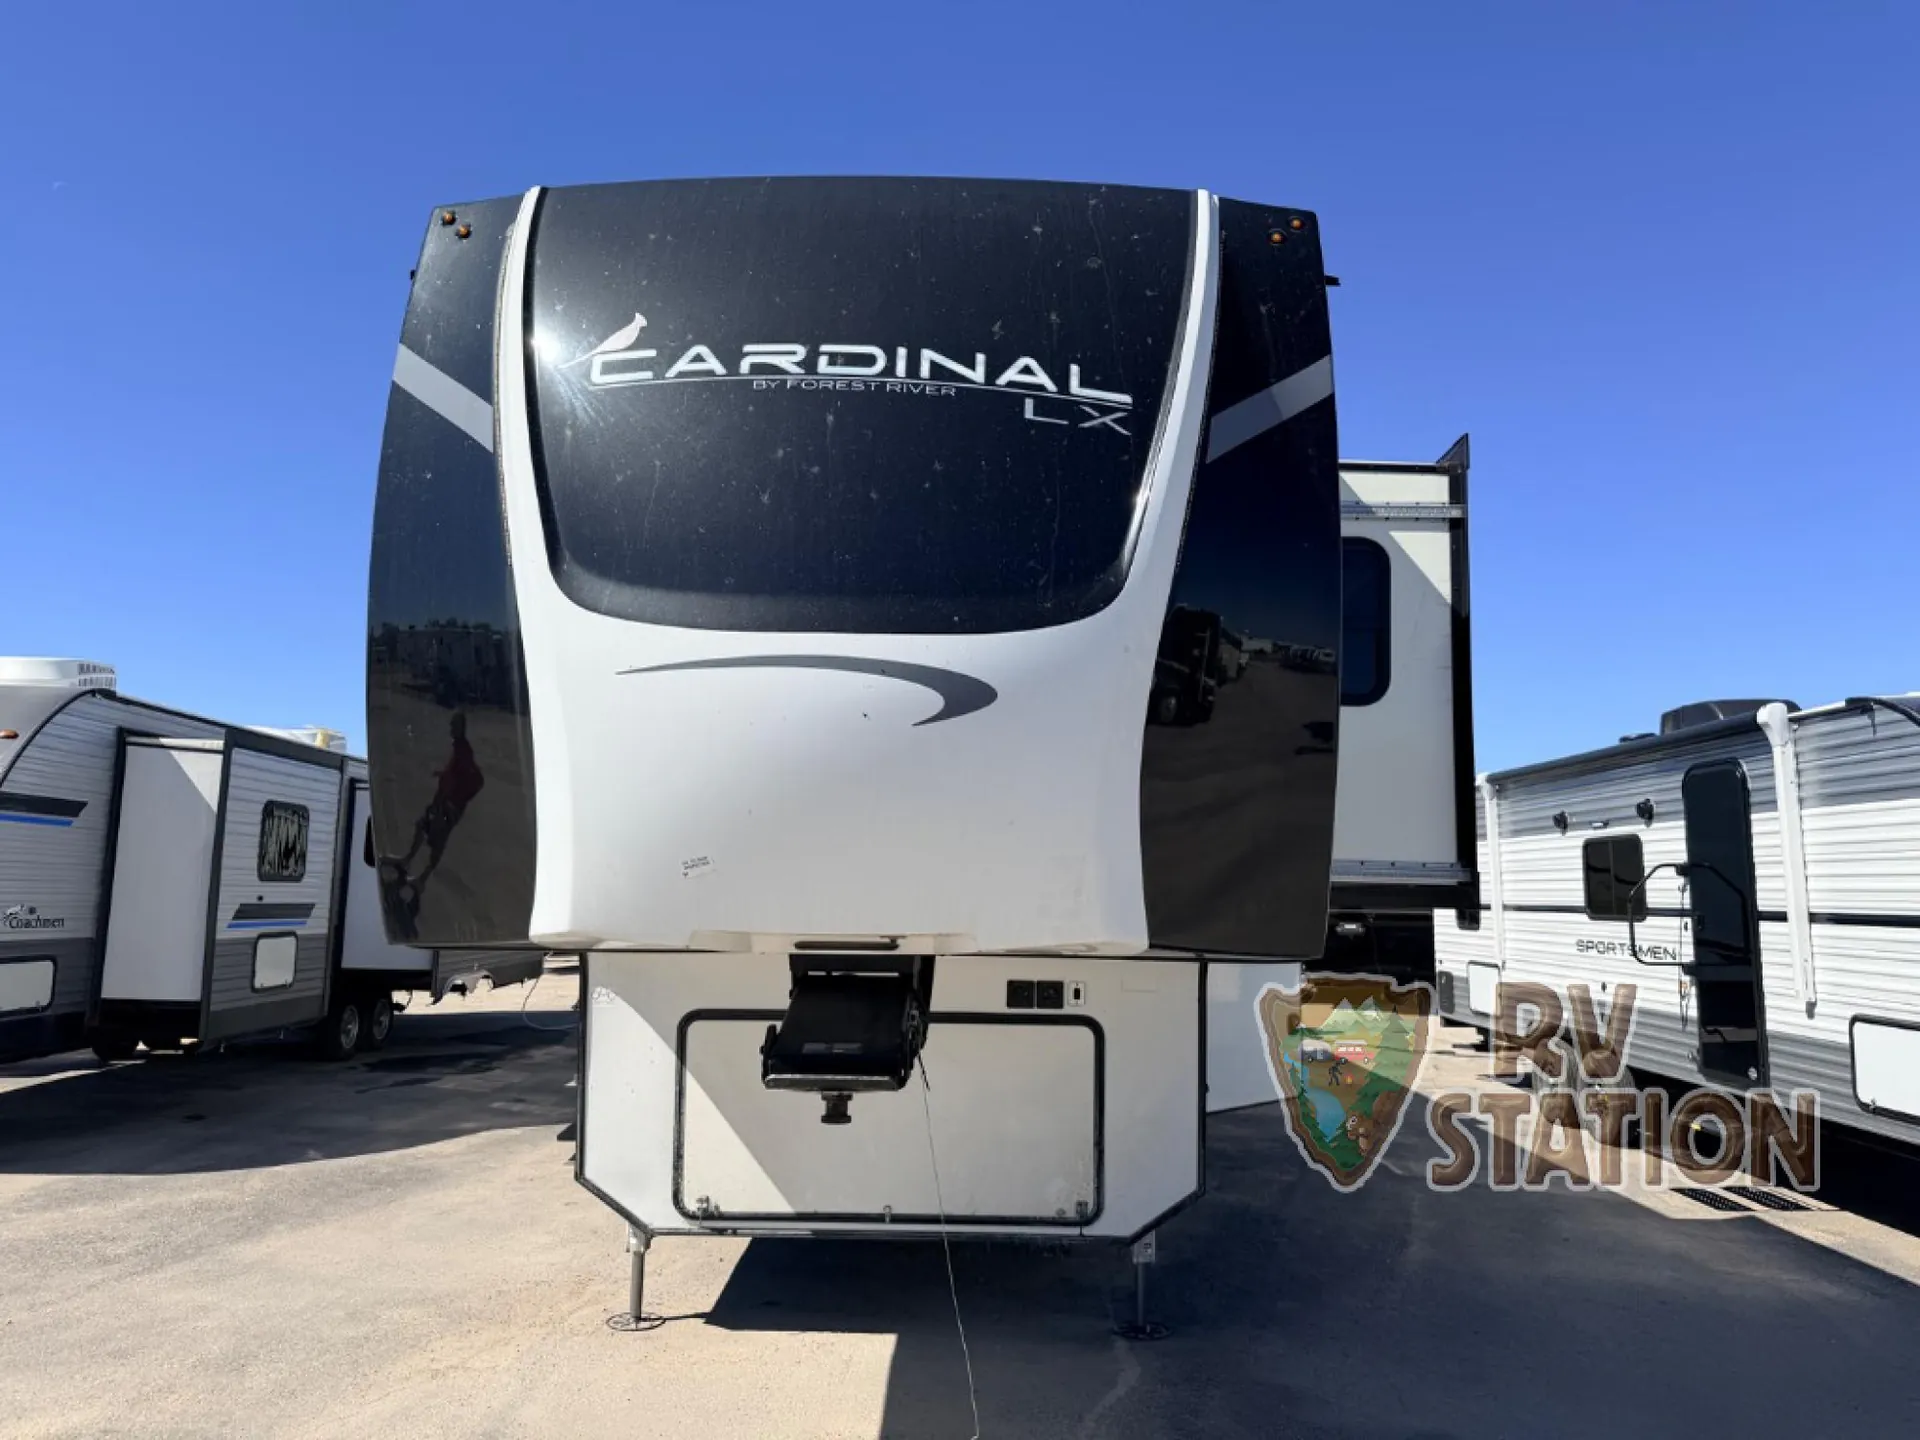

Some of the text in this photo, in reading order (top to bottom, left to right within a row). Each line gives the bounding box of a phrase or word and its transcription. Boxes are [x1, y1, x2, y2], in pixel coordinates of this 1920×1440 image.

[590, 343, 1132, 402] CARDINAL
[753, 379, 956, 397] BY FOREST RIVER
[1024, 399, 1131, 435] LX
